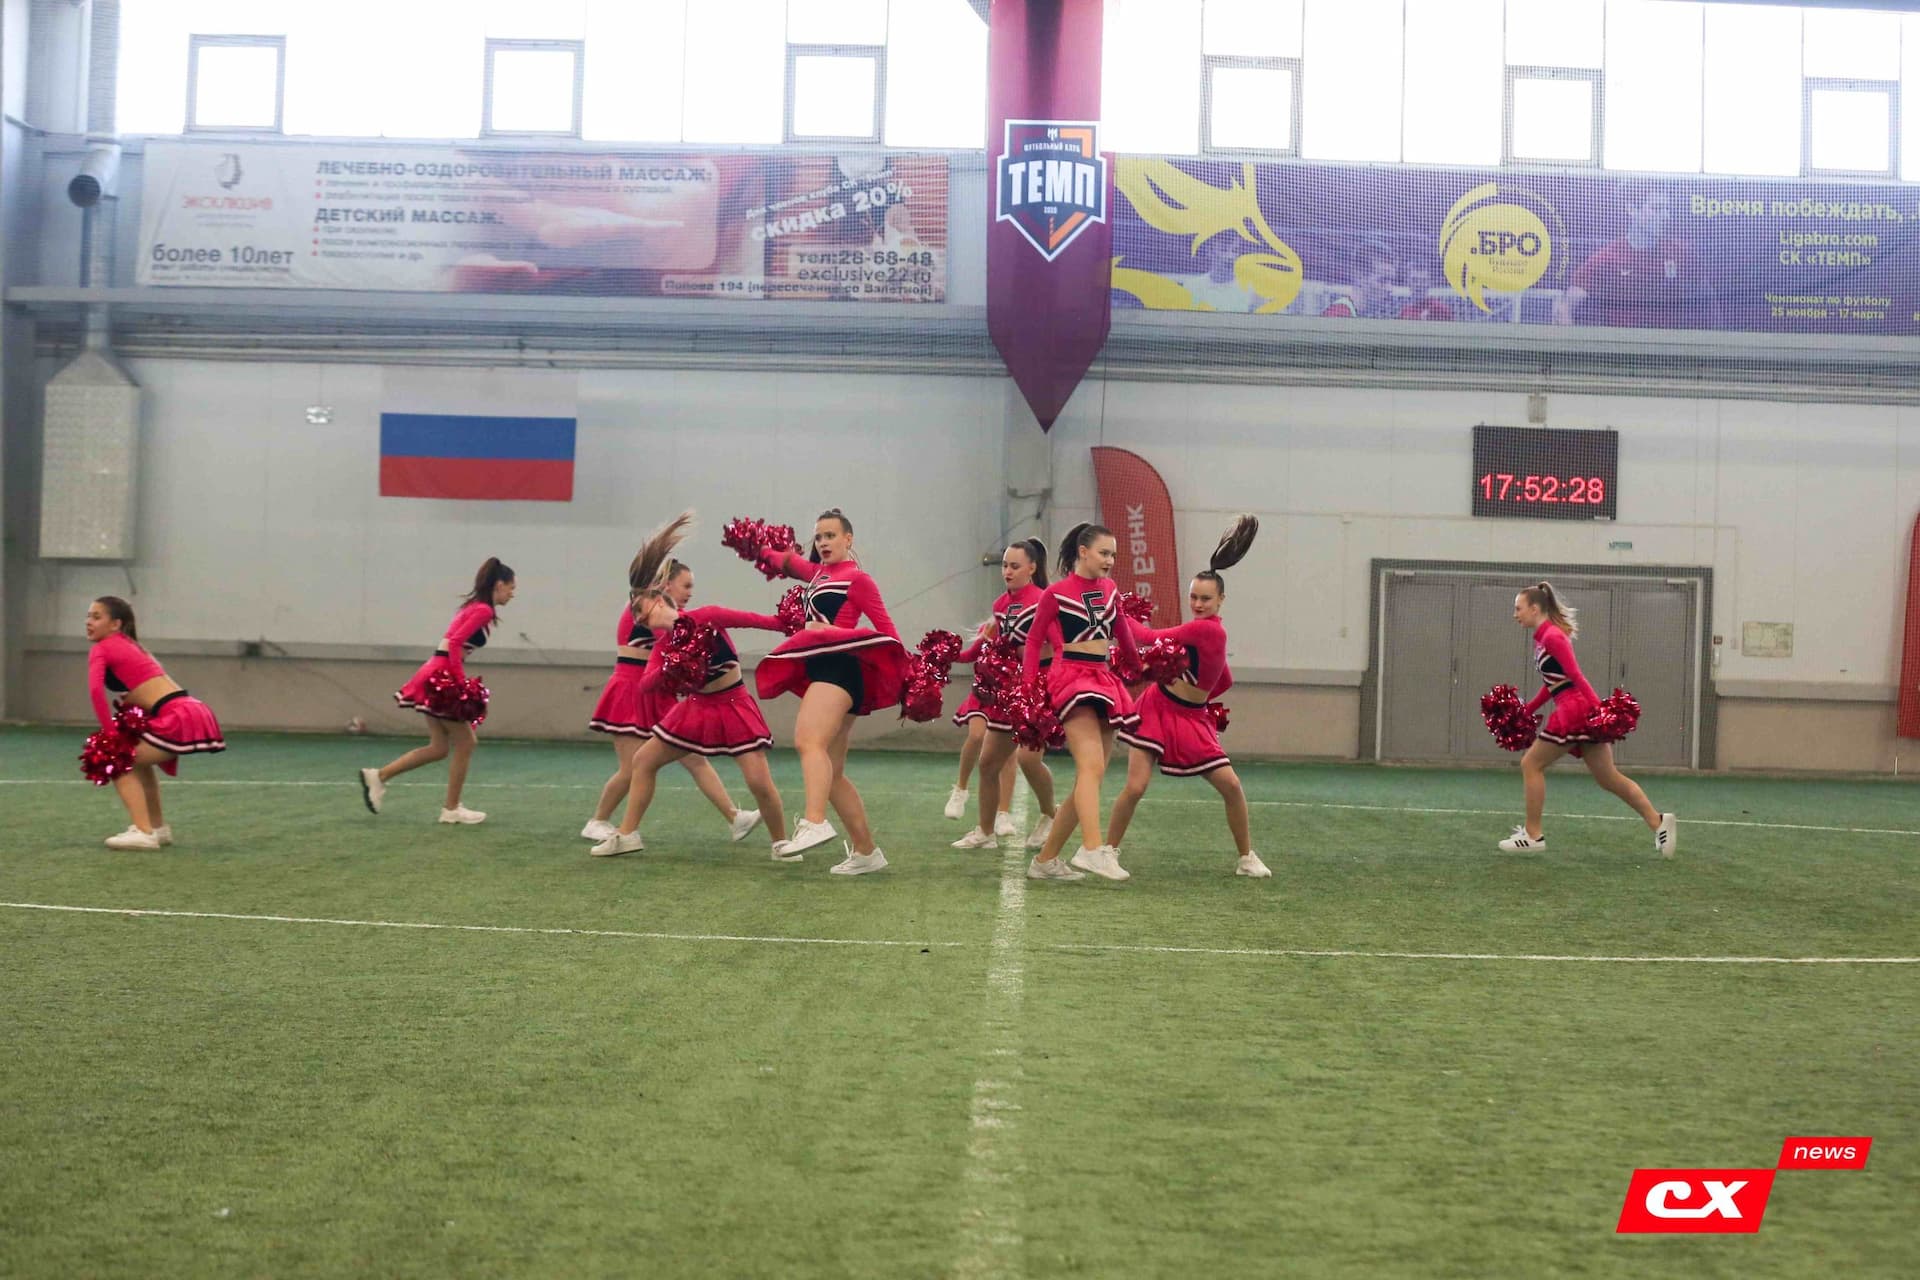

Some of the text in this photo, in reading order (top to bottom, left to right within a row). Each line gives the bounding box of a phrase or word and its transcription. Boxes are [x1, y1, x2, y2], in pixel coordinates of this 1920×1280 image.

[316, 160, 712, 181] ЛЕЧЕБНО-ОЗДОРОВИТЕЛЬНЫЙ МАССАЖ:
[1009, 160, 1095, 208] ТЕМП
[314, 207, 504, 225] ДЕТСКИЙ МАССАЖ:
[752, 179, 913, 241] скидка 20%
[1691, 195, 1765, 218] Время
[1771, 198, 1904, 223] побеждать,
[1779, 231, 1878, 248] Ligabro.com
[152, 244, 294, 264] более 10лет
[1779, 250, 1872, 267] СК «ТЕМП»
[798, 267, 931, 283] exclusive22.ru
[719, 281, 743, 292] 194
[1764, 292, 1892, 307] Чемпионат по футболу
[1786, 307, 1828, 319] ноября
[1838, 308, 1850, 318] 17
[1852, 310, 1885, 320] марта
[1481, 473, 1604, 504] 17:52:28
[1081, 591, 1106, 628] F
